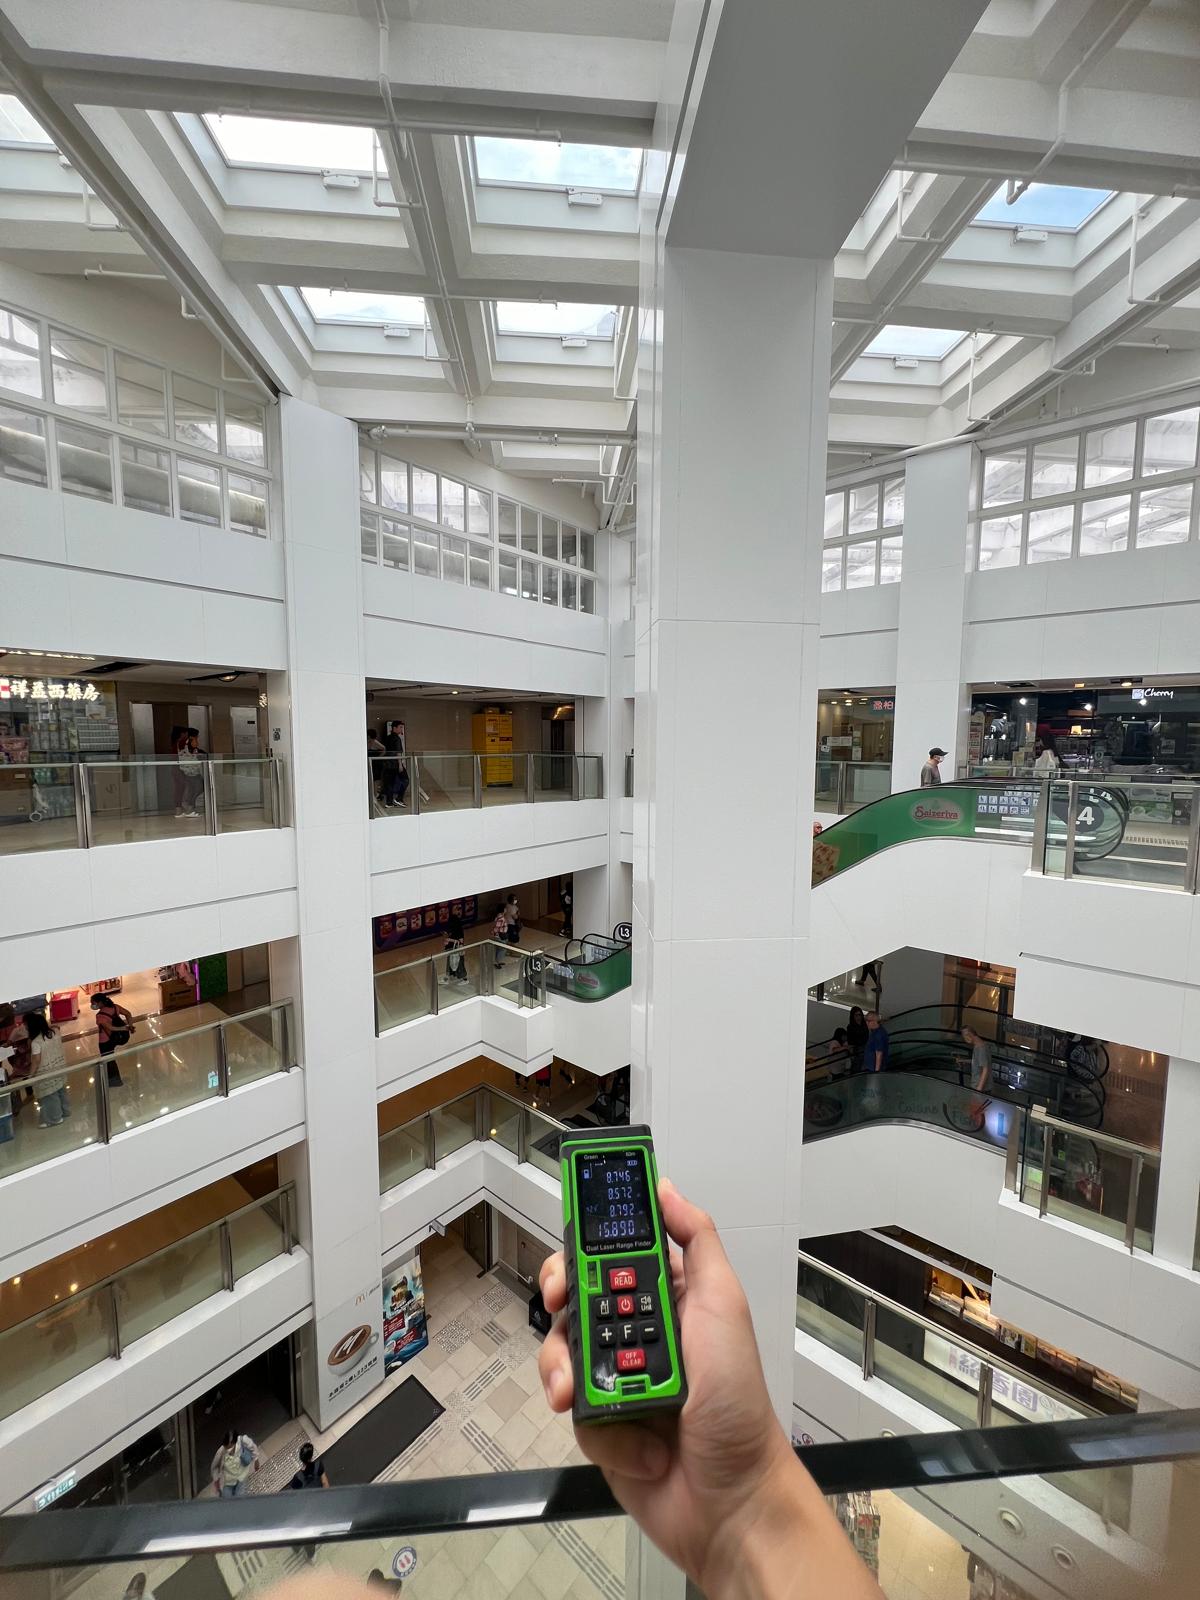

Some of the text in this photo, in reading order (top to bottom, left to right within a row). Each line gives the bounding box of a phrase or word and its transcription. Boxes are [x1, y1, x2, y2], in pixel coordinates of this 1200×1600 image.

[1144, 687, 1174, 699] Cherry
[620, 927, 630, 938] L3
[532, 958, 542, 972] L3
[606, 1170, 631, 1184] 8.746
[608, 1187, 633, 1200] 8.572
[609, 1203, 635, 1218] 8.792
[599, 1219, 635, 1238] 15.890
[600, 1243, 615, 1251] Laser
[616, 1242, 634, 1250] Range
[614, 1276, 633, 1286] READ
[624, 1324, 632, 1340] F
[622, 1358, 642, 1367] CLEAR
